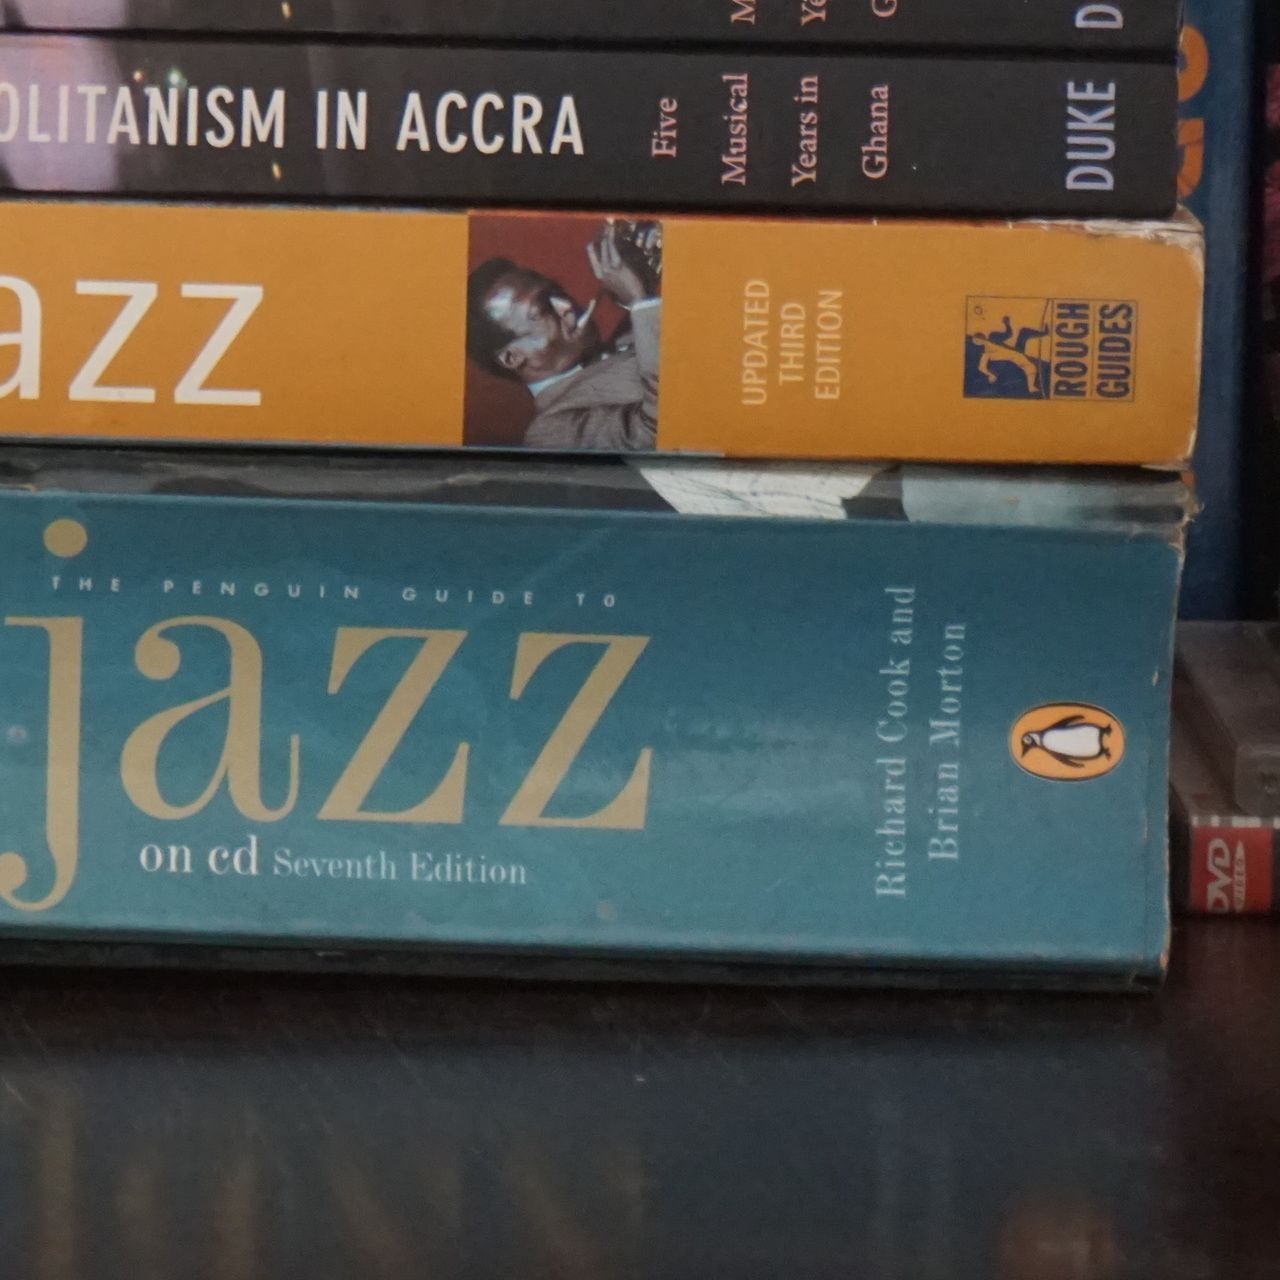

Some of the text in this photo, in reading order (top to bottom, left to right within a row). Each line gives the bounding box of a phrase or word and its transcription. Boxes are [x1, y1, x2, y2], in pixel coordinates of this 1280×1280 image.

[315, 91, 367, 151] IN
[396, 92, 585, 156] ACCRA
[650, 97, 678, 159] Five
[721, 73, 749, 187] Musical
[790, 75, 819, 187] Years in
[861, 84, 890, 180] Ghana
[1066, 80, 1116, 191] DUKE
[741, 278, 770, 407] UPDATED
[778, 302, 807, 387] THIRD
[815, 289, 844, 400] EDITION
[1052, 301, 1090, 397] ROUGH
[1095, 302, 1133, 399] GUIDES
[51, 577, 616, 608] THE PENGUIN GUIDE TO
[875, 587, 916, 896] Richard Cook and
[928, 623, 966, 859] Brian Morton
[140, 835, 527, 885] on cd Seventh Edition
[1207, 837, 1231, 913] DVD
